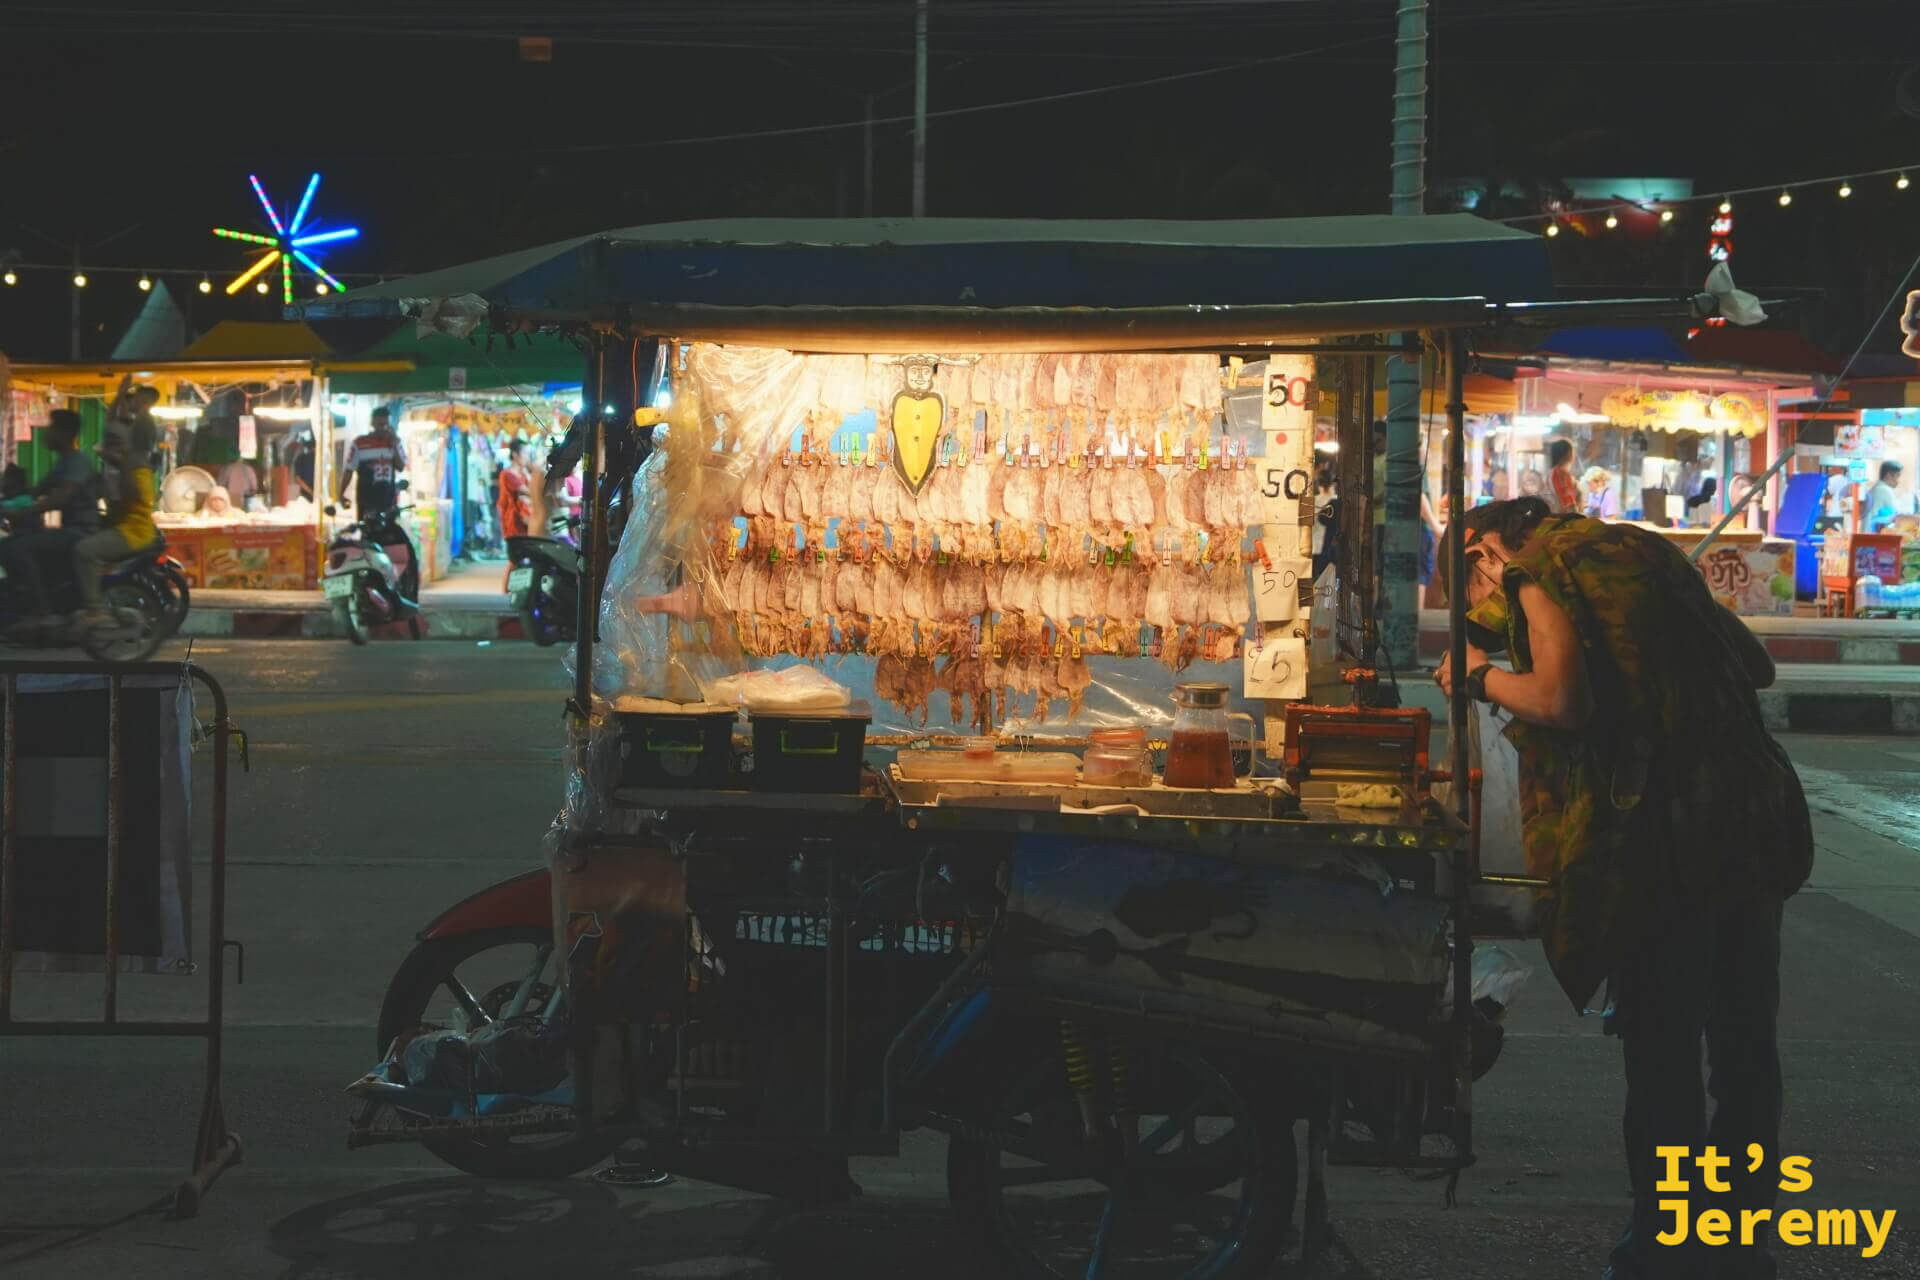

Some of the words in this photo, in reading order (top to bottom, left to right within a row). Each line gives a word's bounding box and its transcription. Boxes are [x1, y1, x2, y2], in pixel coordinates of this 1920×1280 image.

[1269, 373, 1308, 407] 50
[1261, 469, 1309, 500] 50
[1261, 570, 1296, 595] 50
[1248, 646, 1291, 684] 25
